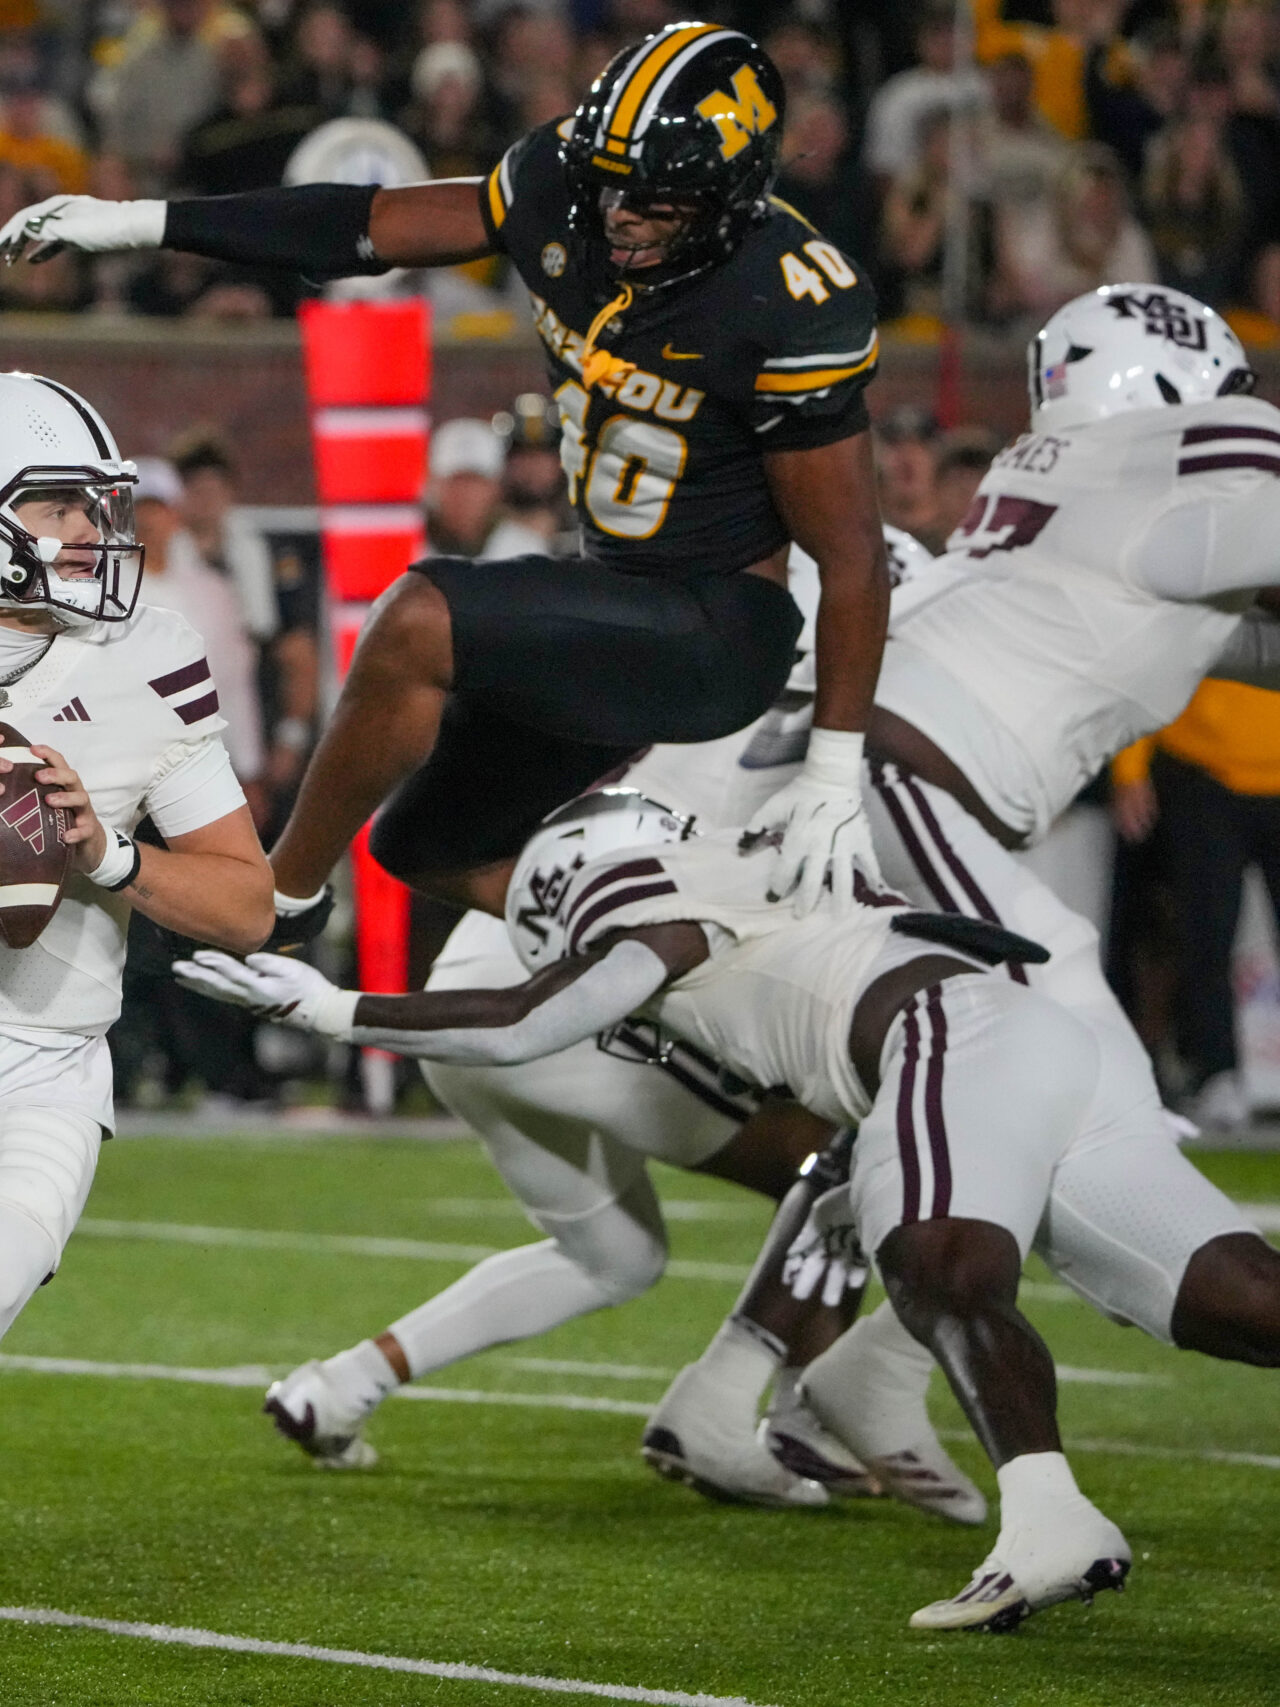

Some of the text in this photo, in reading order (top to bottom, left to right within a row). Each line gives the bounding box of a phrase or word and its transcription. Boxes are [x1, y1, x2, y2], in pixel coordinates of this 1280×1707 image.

[693, 63, 777, 163] M
[780, 239, 858, 305] 40
[1106, 292, 1208, 352] MSU
[553, 376, 689, 541] 40
